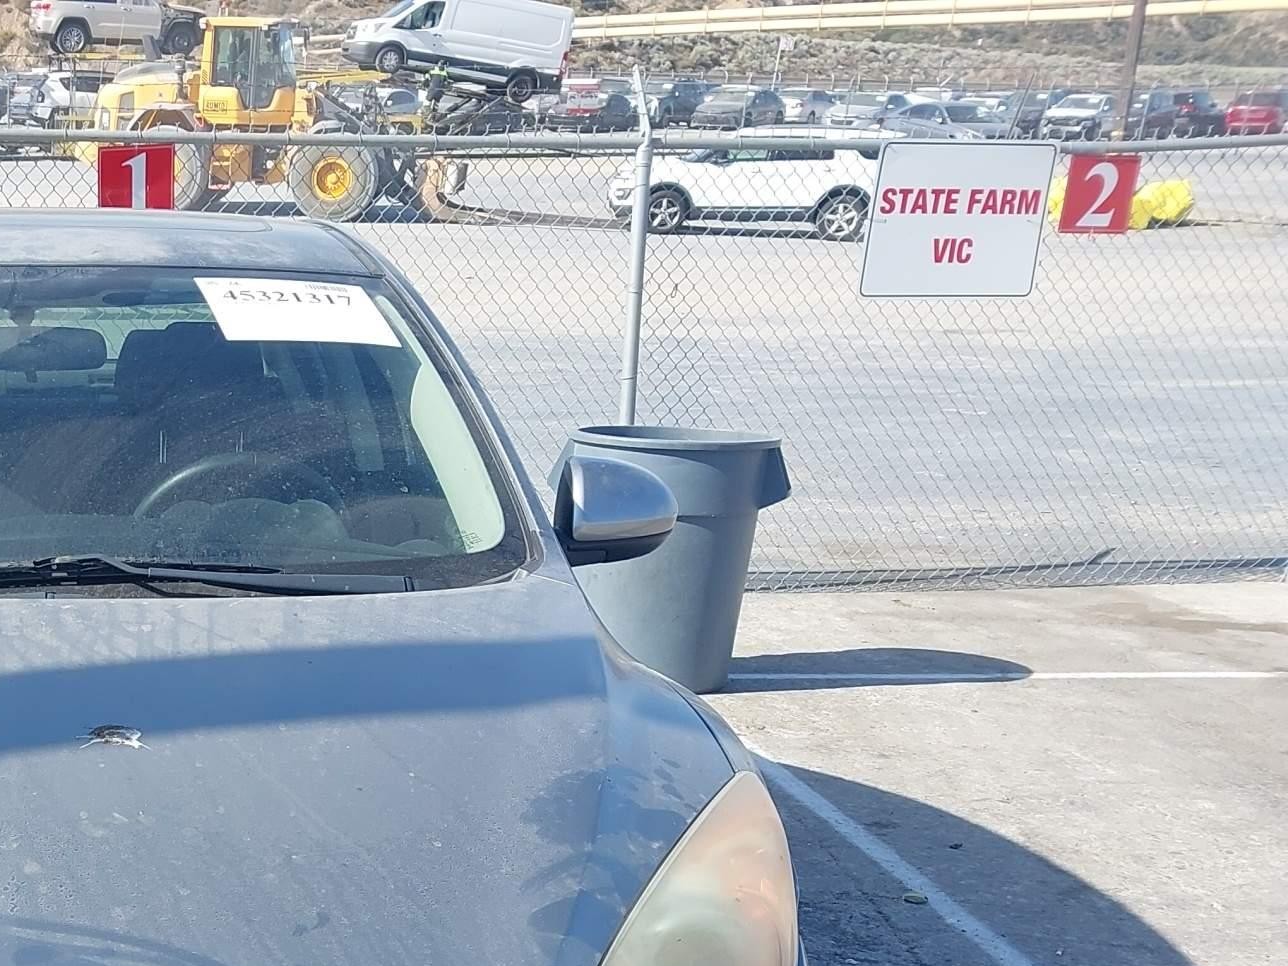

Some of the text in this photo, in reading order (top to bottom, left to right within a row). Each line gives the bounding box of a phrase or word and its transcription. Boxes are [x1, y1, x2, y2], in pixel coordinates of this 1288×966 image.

[121, 151, 147, 210] 1
[1075, 161, 1120, 228] 2
[879, 187, 1042, 216] STATE FARM
[932, 237, 974, 265] VIC
[222, 289, 352, 307] 45321317
